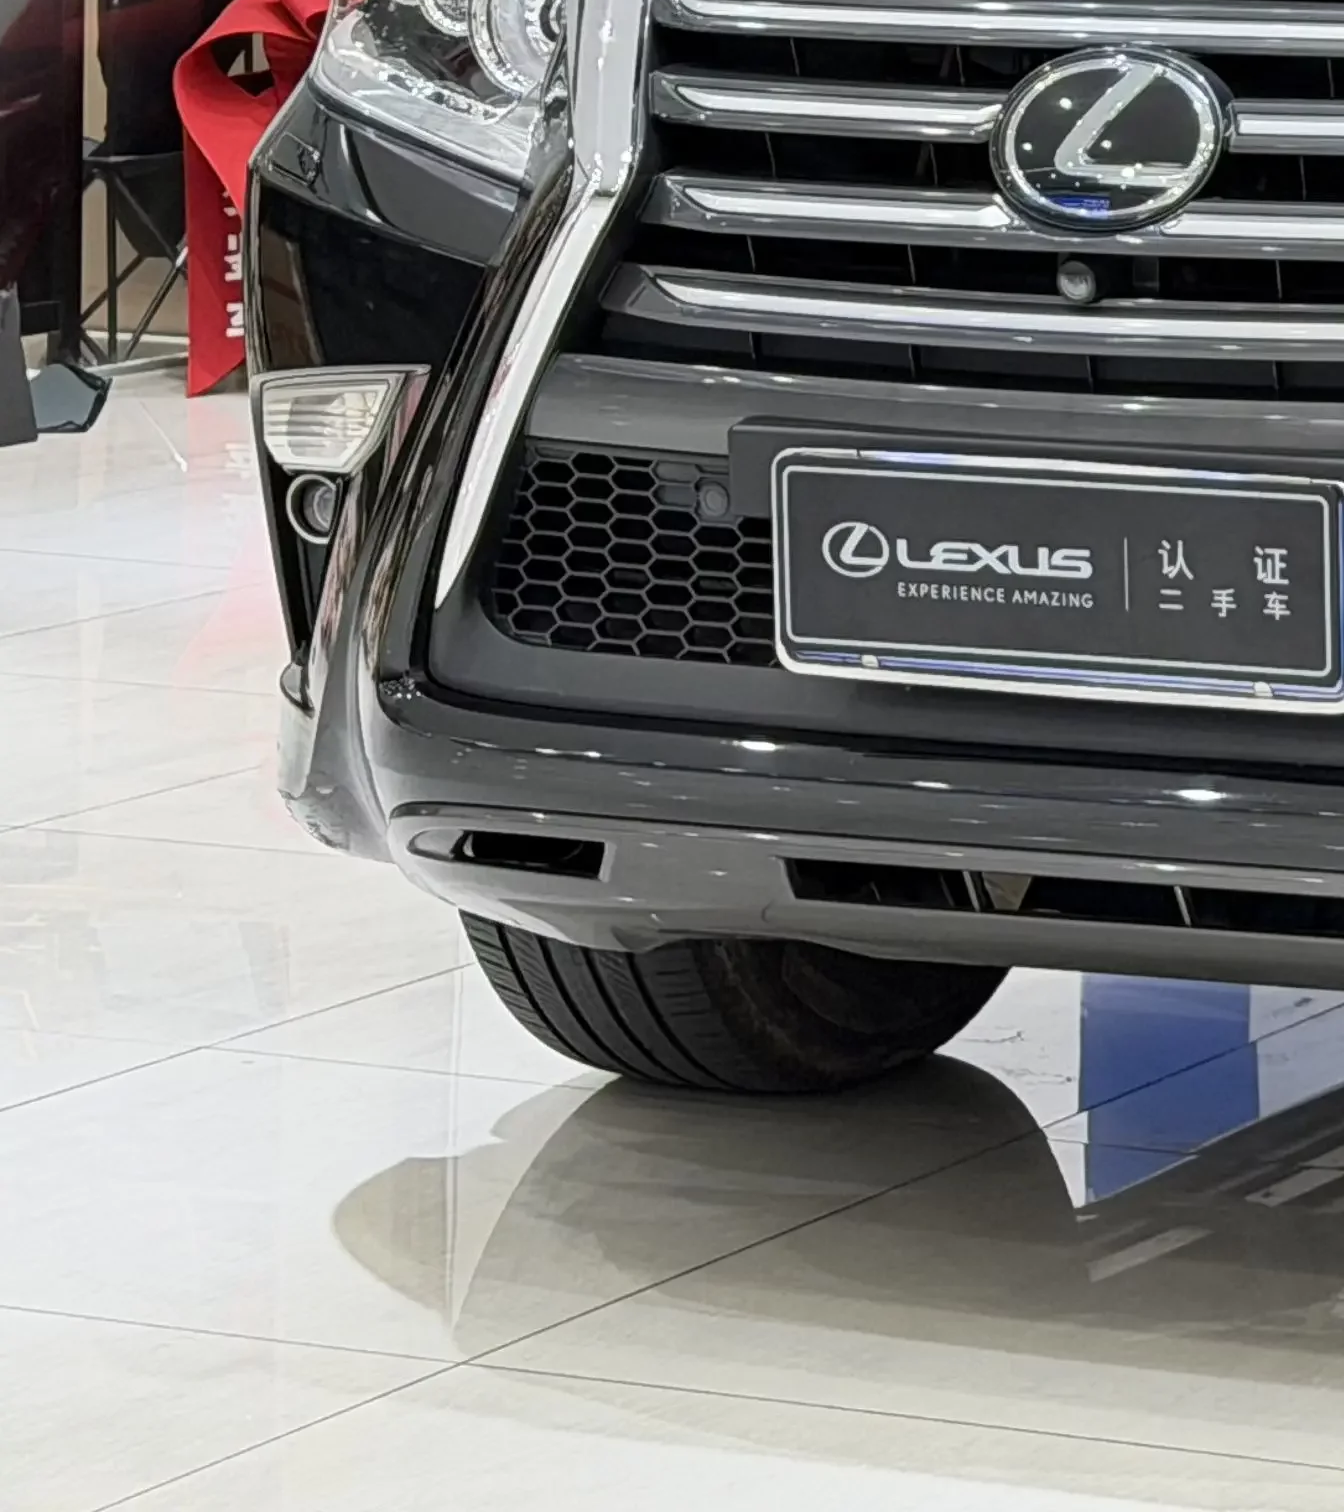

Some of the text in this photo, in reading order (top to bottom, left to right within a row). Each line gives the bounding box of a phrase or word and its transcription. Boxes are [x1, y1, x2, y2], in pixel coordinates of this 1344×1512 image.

[896, 538, 1093, 579] LEXUS
[897, 581, 1094, 608] EXPERIENCE AMAZING
[1158, 588, 1291, 621] 二手车
